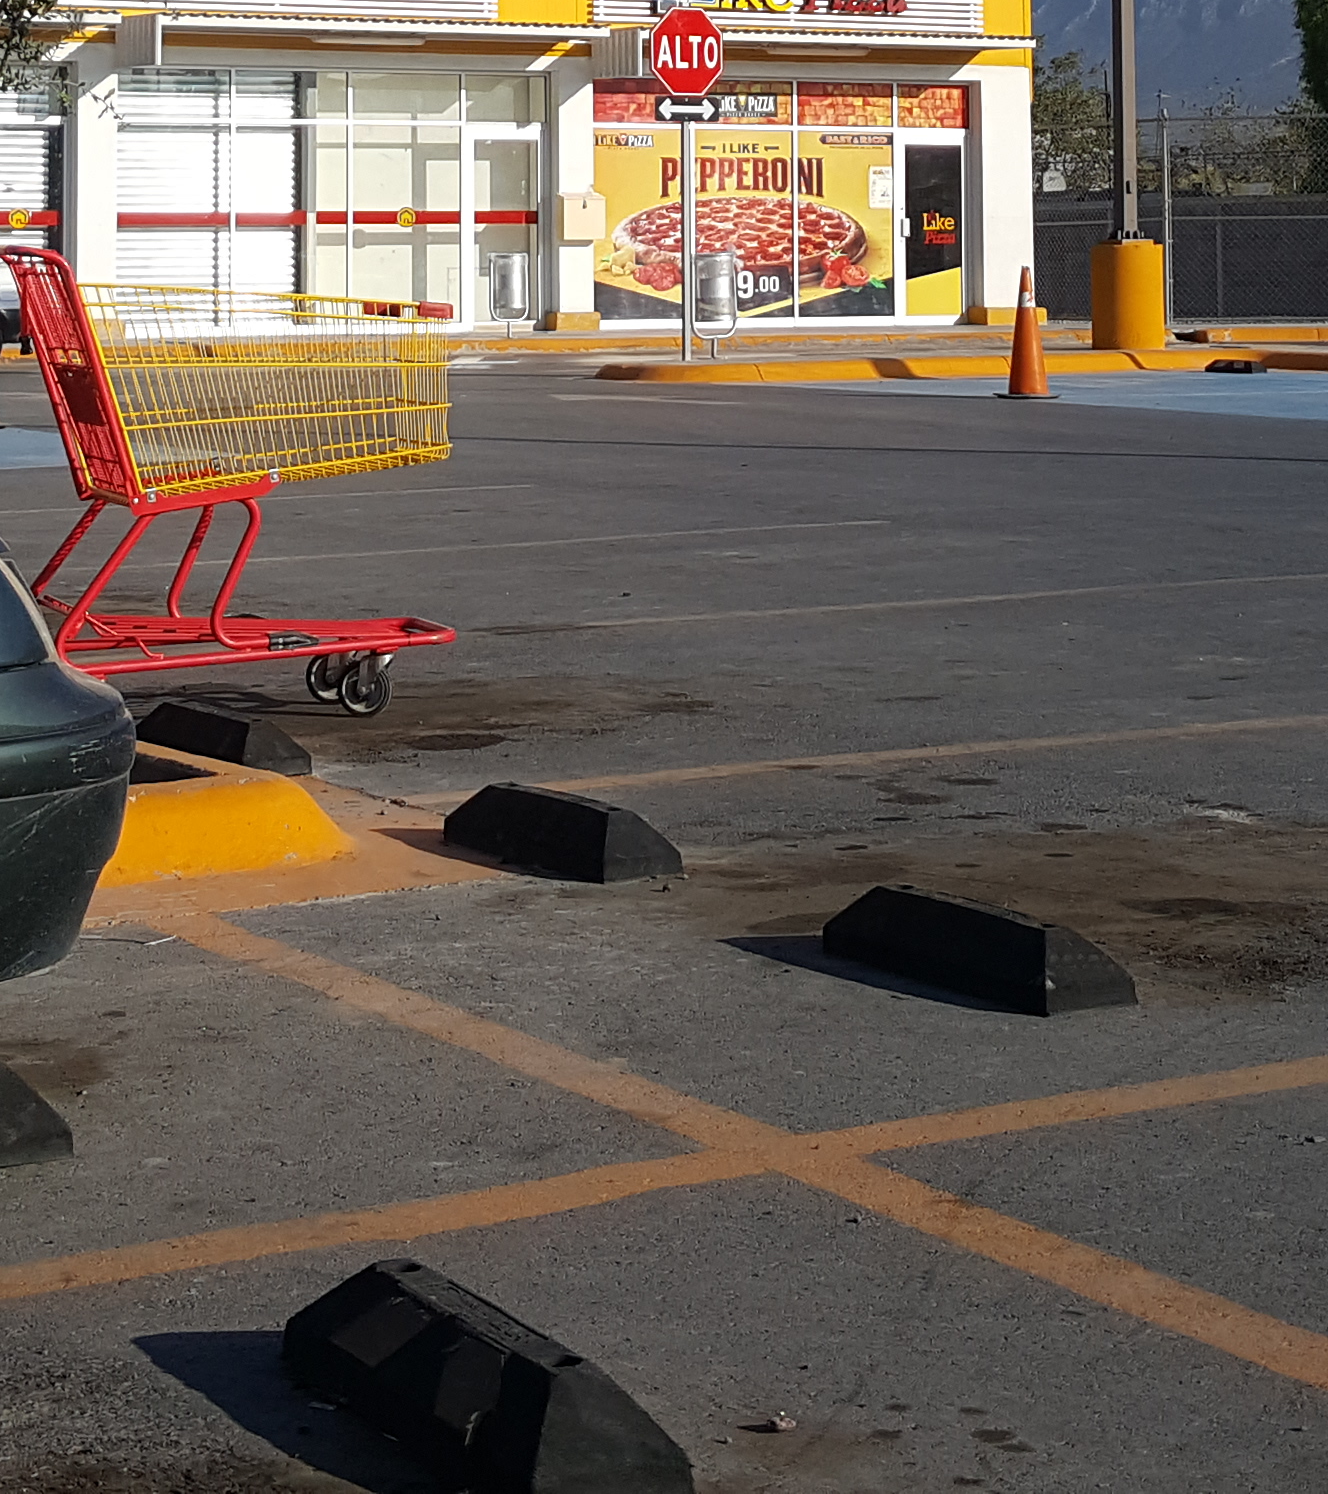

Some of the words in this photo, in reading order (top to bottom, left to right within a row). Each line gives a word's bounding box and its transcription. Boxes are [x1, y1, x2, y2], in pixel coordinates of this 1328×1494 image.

[657, 35, 719, 69] ALTO
[722, 143, 726, 153] I
[729, 143, 760, 153] LIKE
[660, 156, 825, 199] PPPERONI
[922, 211, 955, 230] Like
